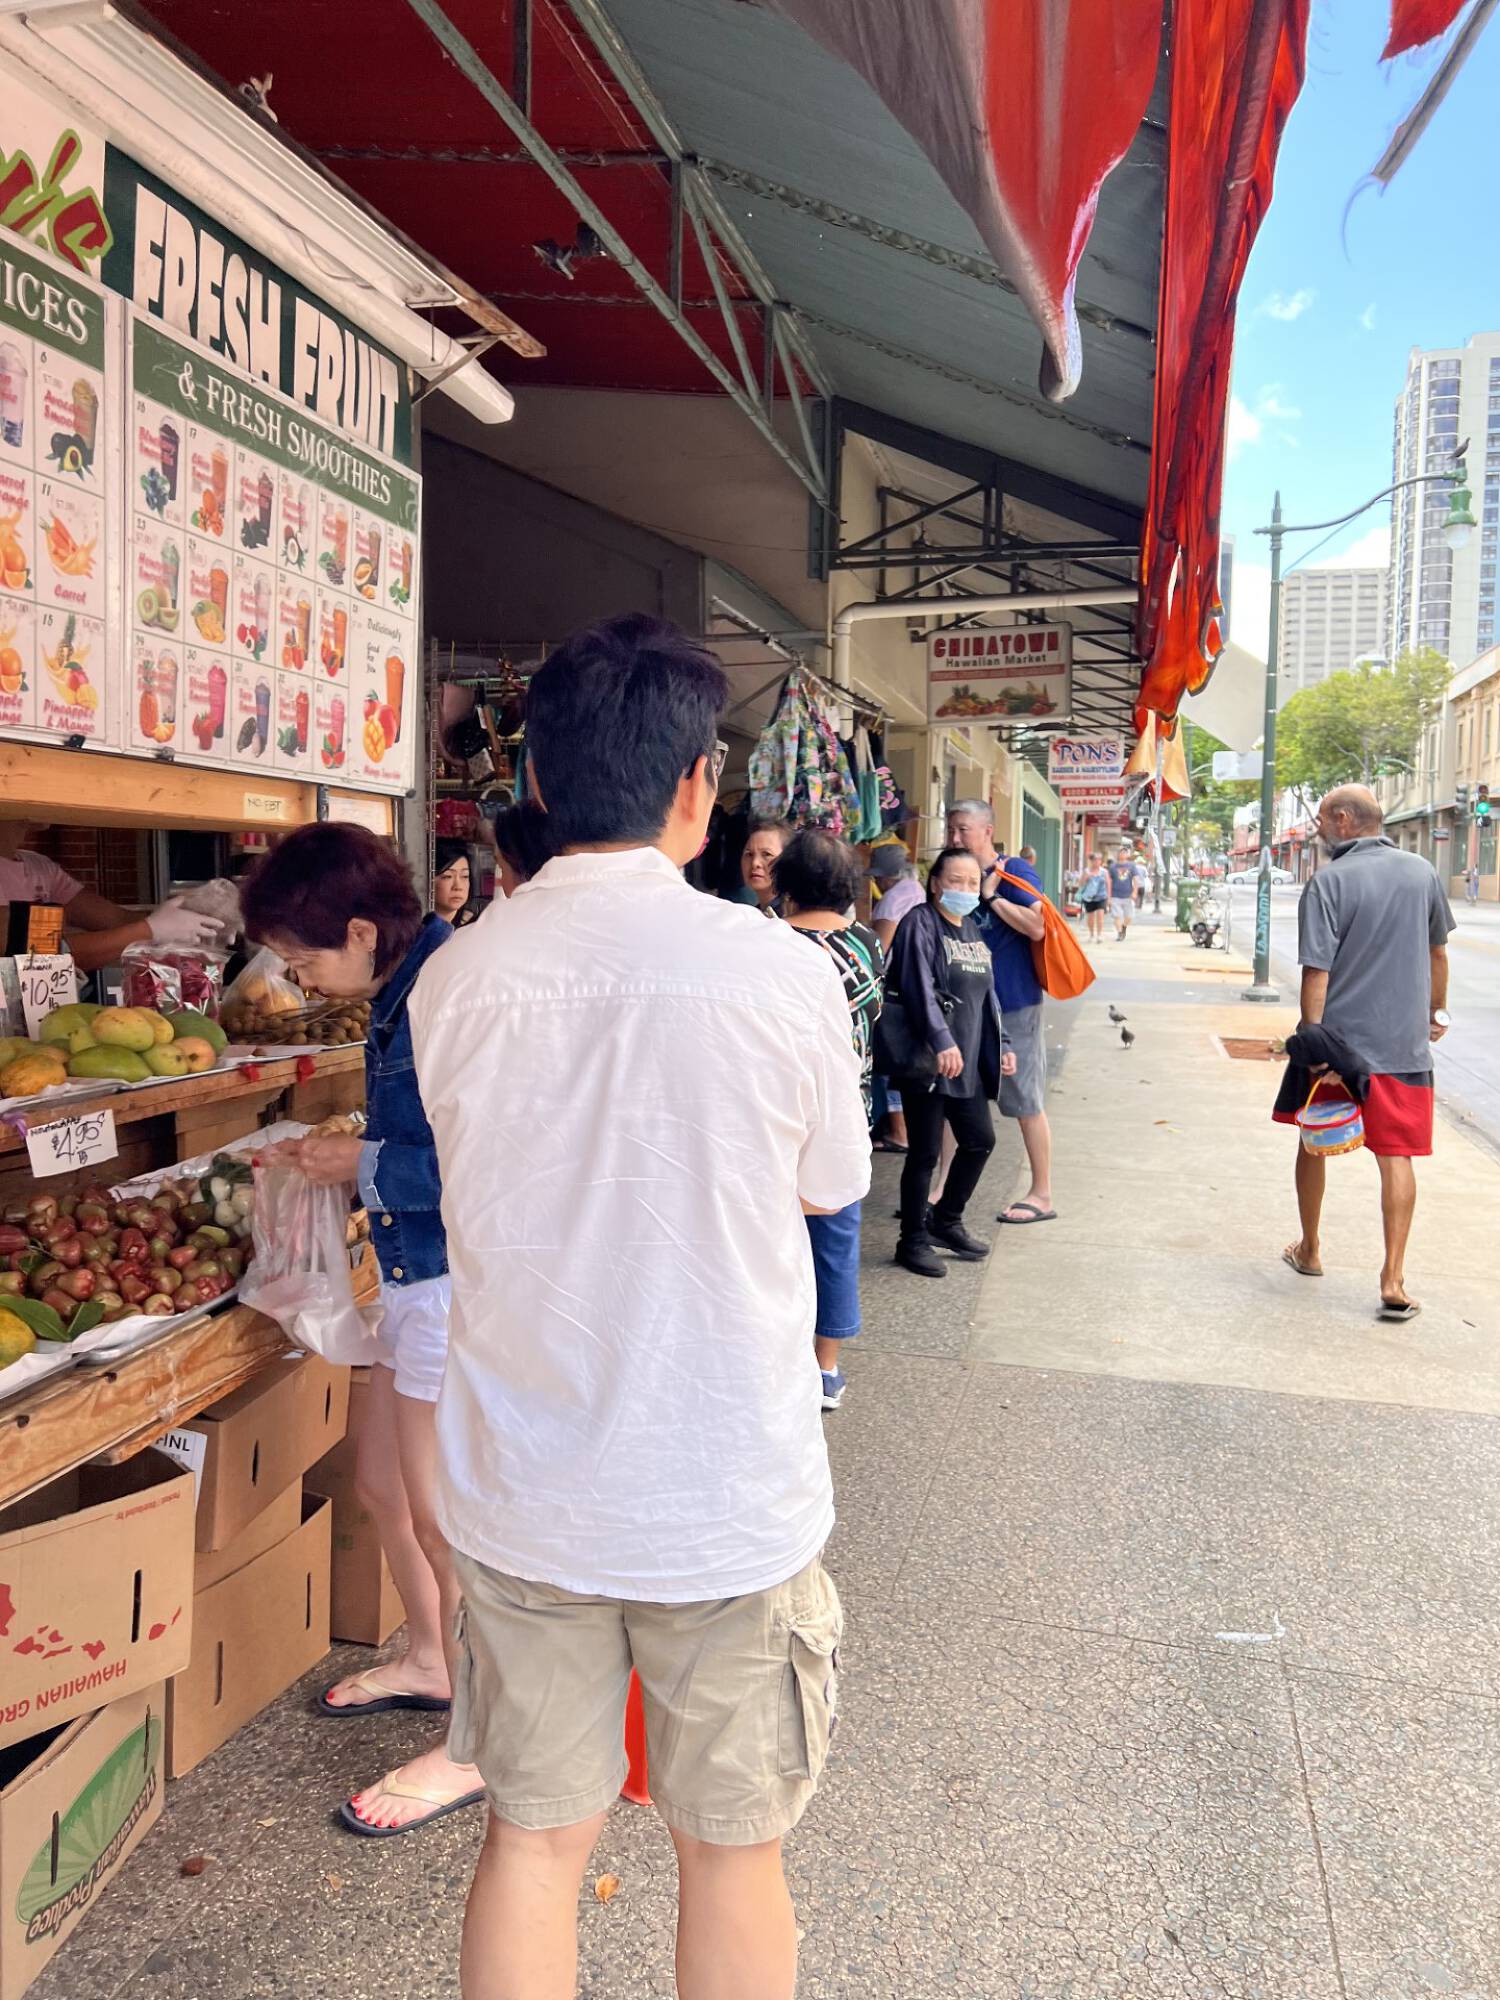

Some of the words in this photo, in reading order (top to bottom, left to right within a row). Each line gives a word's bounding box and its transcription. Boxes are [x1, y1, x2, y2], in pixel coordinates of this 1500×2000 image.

[0, 257, 88, 345] ICES
[133, 183, 281, 391] FRESH
[294, 297, 400, 457] FRUIT
[40, 352, 47, 364] 6
[178, 361, 198, 402] &
[206, 373, 282, 449] FRESH
[287, 421, 391, 505] SMOOTHIES
[0, 474, 25, 493] arrot
[42, 483, 52, 496] 11
[54, 584, 86, 604] Carrot
[43, 613, 54, 626] 15
[934, 631, 1058, 657] CHINATOWN
[946, 657, 1000, 667] Hawaiian
[1005, 654, 1047, 665] Market
[44, 699, 95, 719] Pineapple
[56, 718, 95, 733] Mango
[1058, 742, 1119, 763] PON'S
[1066, 787, 1087, 796] GOOD
[1089, 787, 1120, 796] HEALTH
[36, 1658, 127, 1711] HAWAIIAN
[95, 1766, 157, 1879] Hawaiian
[28, 1868, 95, 1940] Produce
